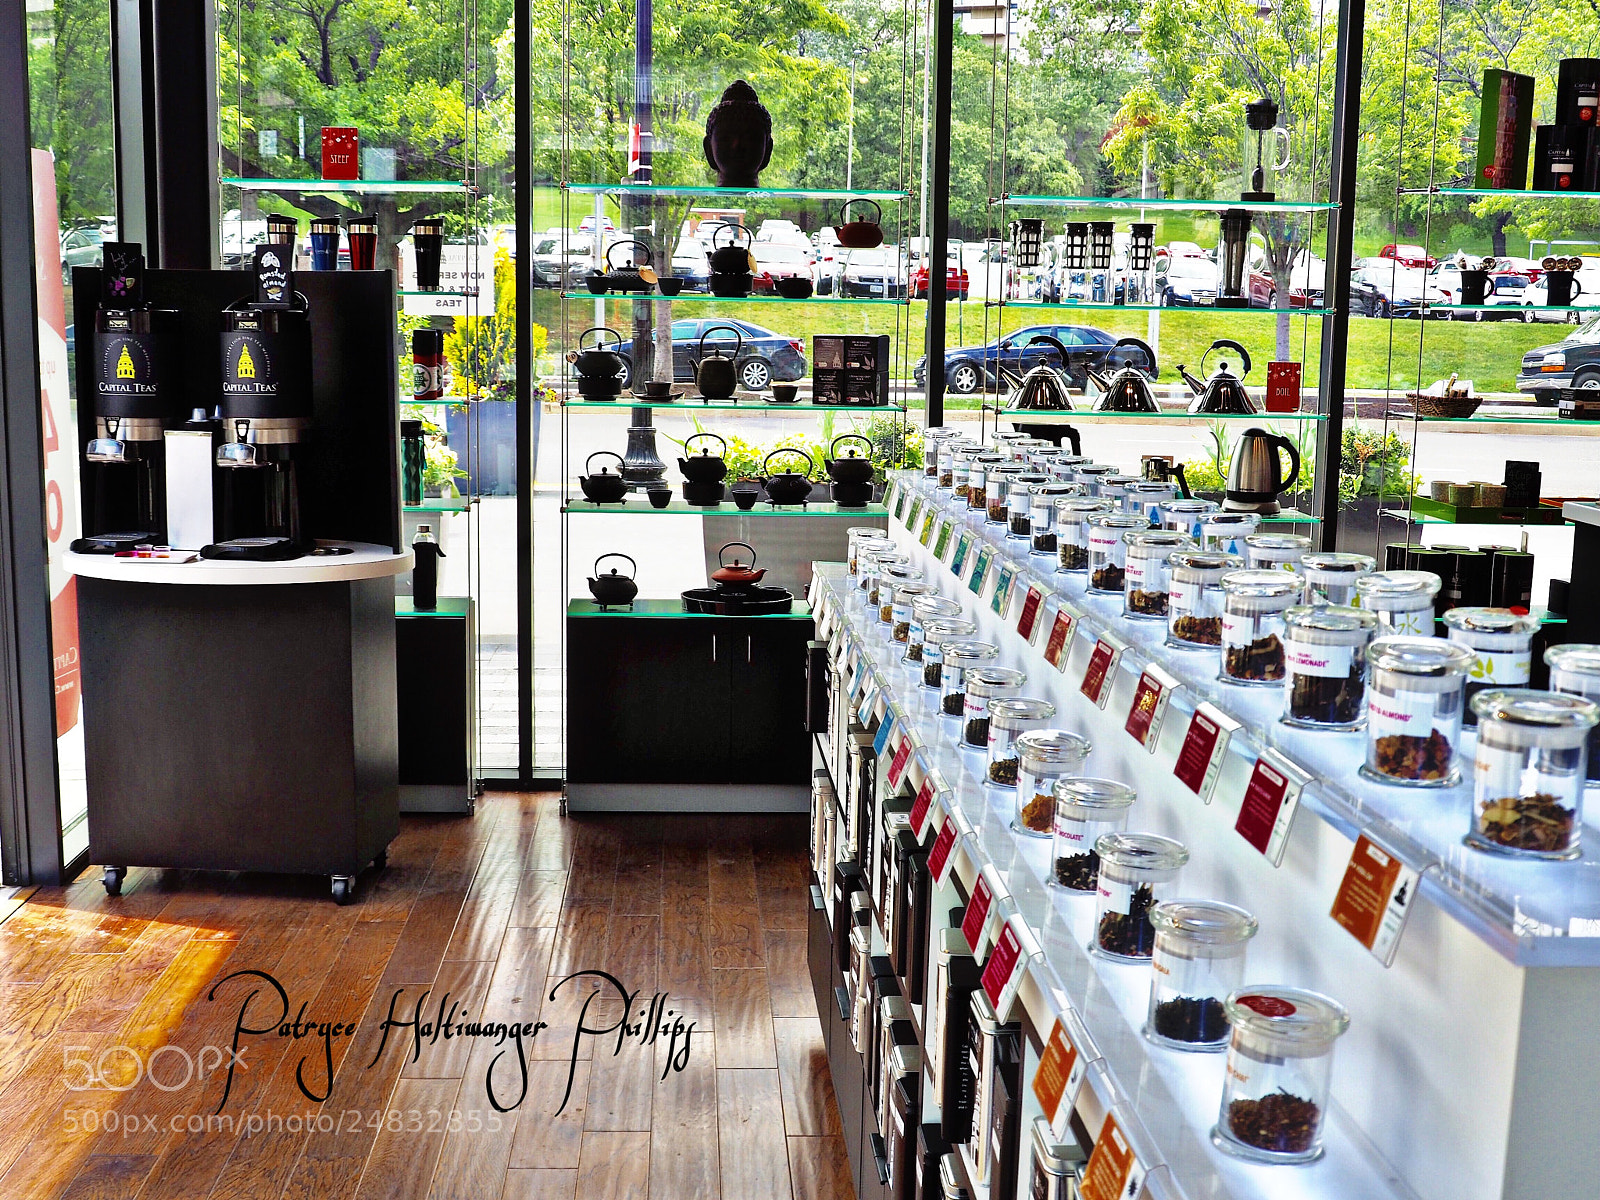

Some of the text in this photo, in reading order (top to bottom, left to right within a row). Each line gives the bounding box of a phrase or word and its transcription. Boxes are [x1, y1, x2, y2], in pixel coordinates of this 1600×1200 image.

[98, 381, 157, 393] CAPITAL TEAS
[222, 381, 277, 392] CAPITAL TEAS
